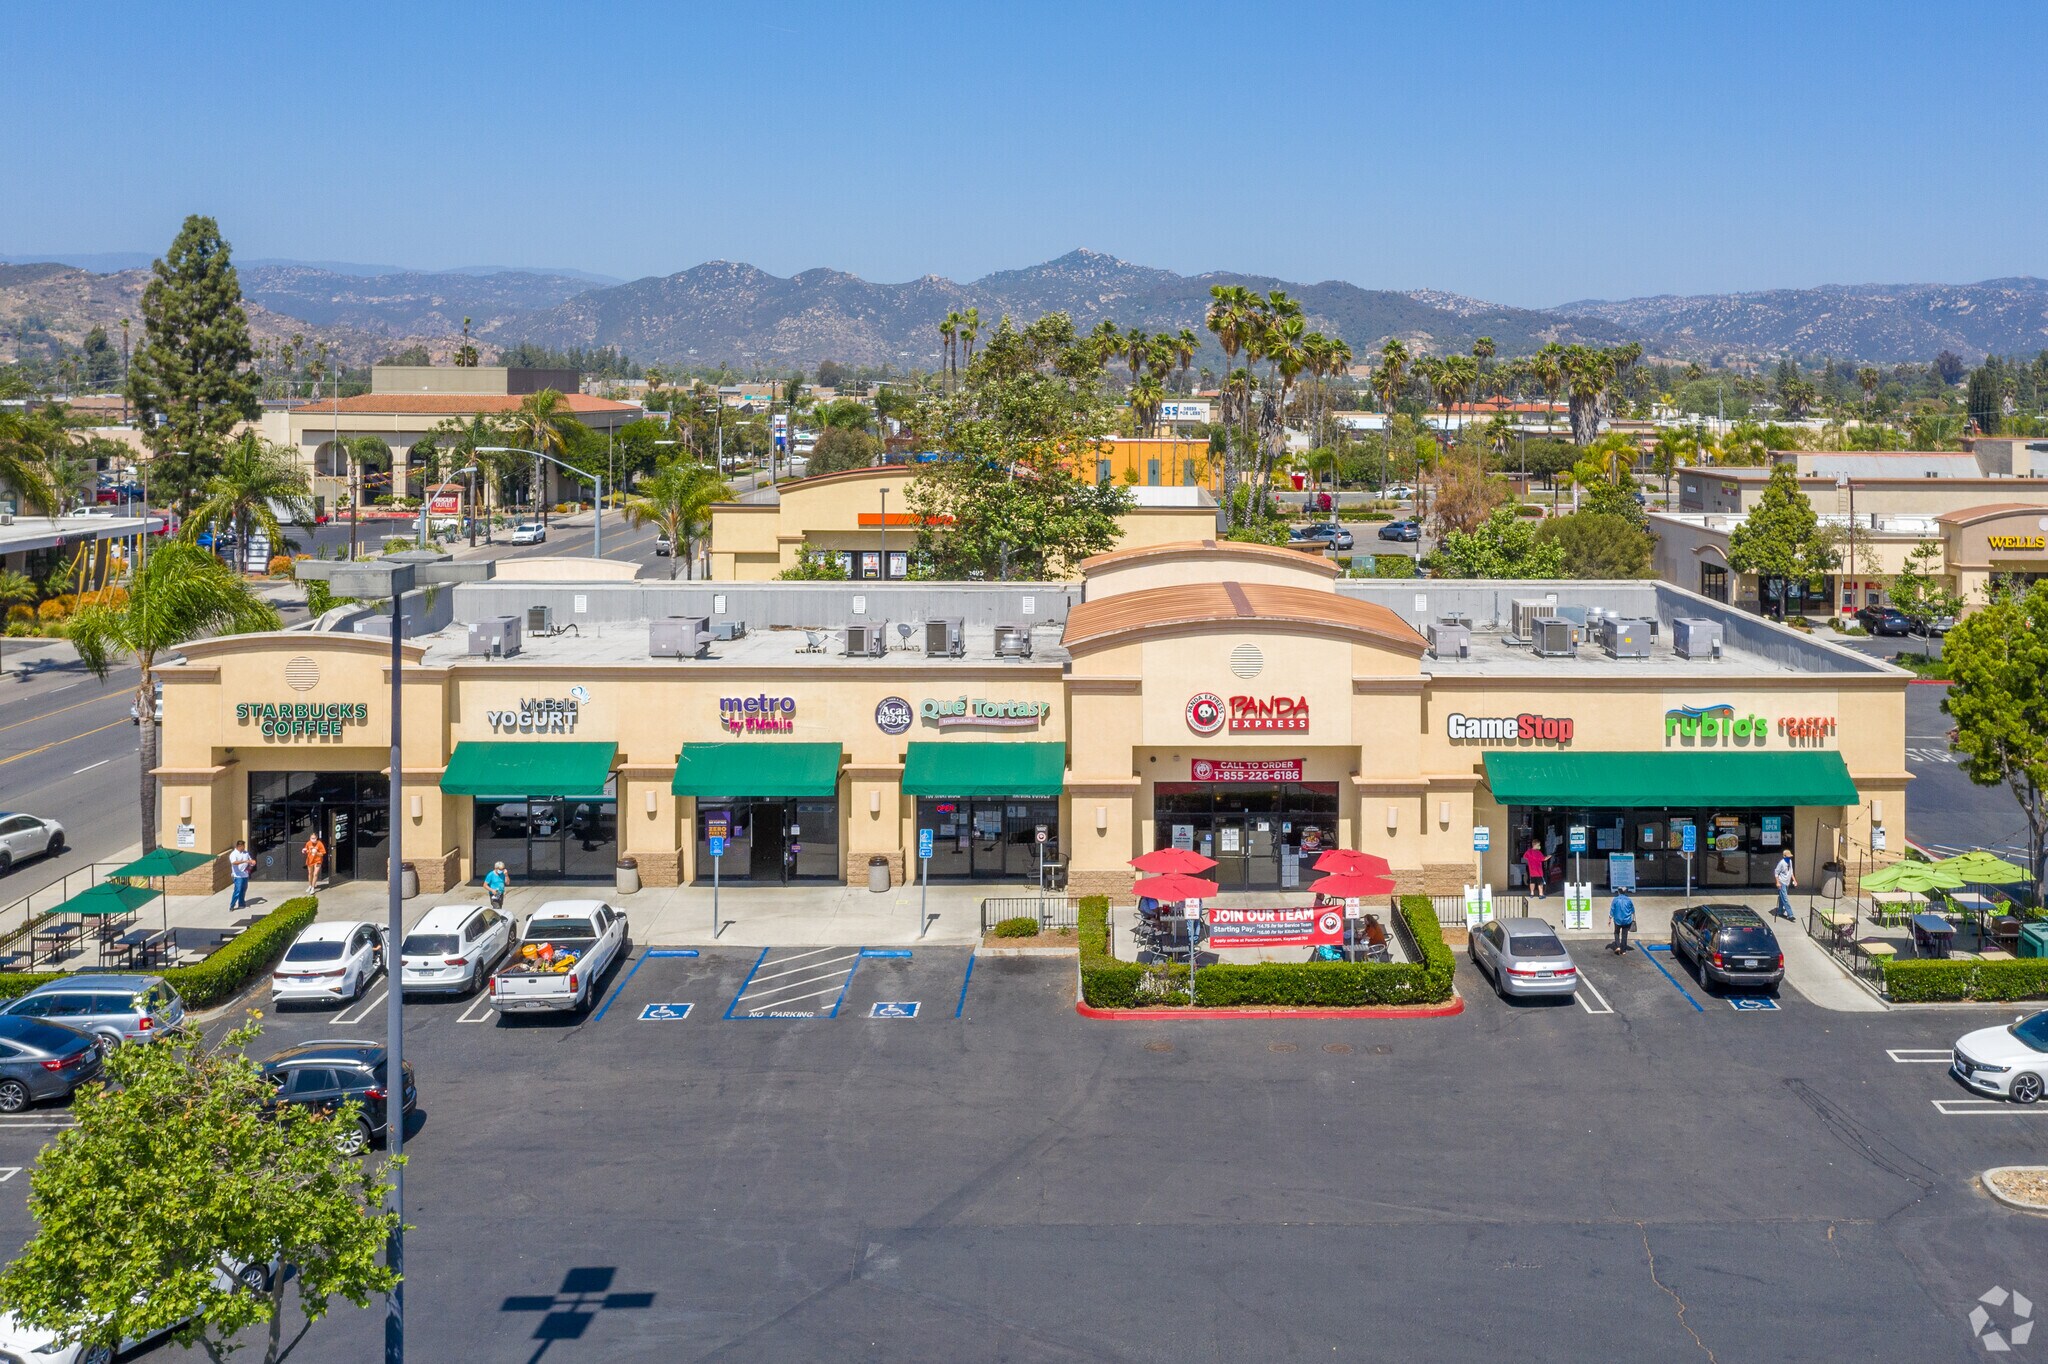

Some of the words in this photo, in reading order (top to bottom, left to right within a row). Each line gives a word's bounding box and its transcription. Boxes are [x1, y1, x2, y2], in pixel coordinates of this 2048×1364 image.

[1988, 536, 2046, 548] WELLS
[720, 693, 796, 713] metro
[920, 695, 968, 719] Qué
[972, 699, 1050, 717] Tortas!
[1188, 695, 1203, 713] PANDA
[1204, 694, 1224, 714] EXPRESS
[1228, 696, 1309, 718] PANDA
[236, 703, 368, 719] STARBUCKS
[487, 711, 577, 726] YOGURT
[261, 720, 342, 736] COFFEE
[729, 718, 743, 732] by
[1232, 720, 1306, 728] EXPRESS
[1448, 712, 1574, 742] GameStop
[1666, 711, 1768, 737] rubio's
[1778, 717, 1838, 726] COASTAL
[1789, 728, 1826, 738] GRILL
[1214, 770, 1300, 780] 1-855-226-6186
[936, 804, 954, 812] OPEN
[1213, 910, 1244, 922] JOIN
[1246, 909, 1275, 922] OUR
[1278, 908, 1314, 920] TEAM
